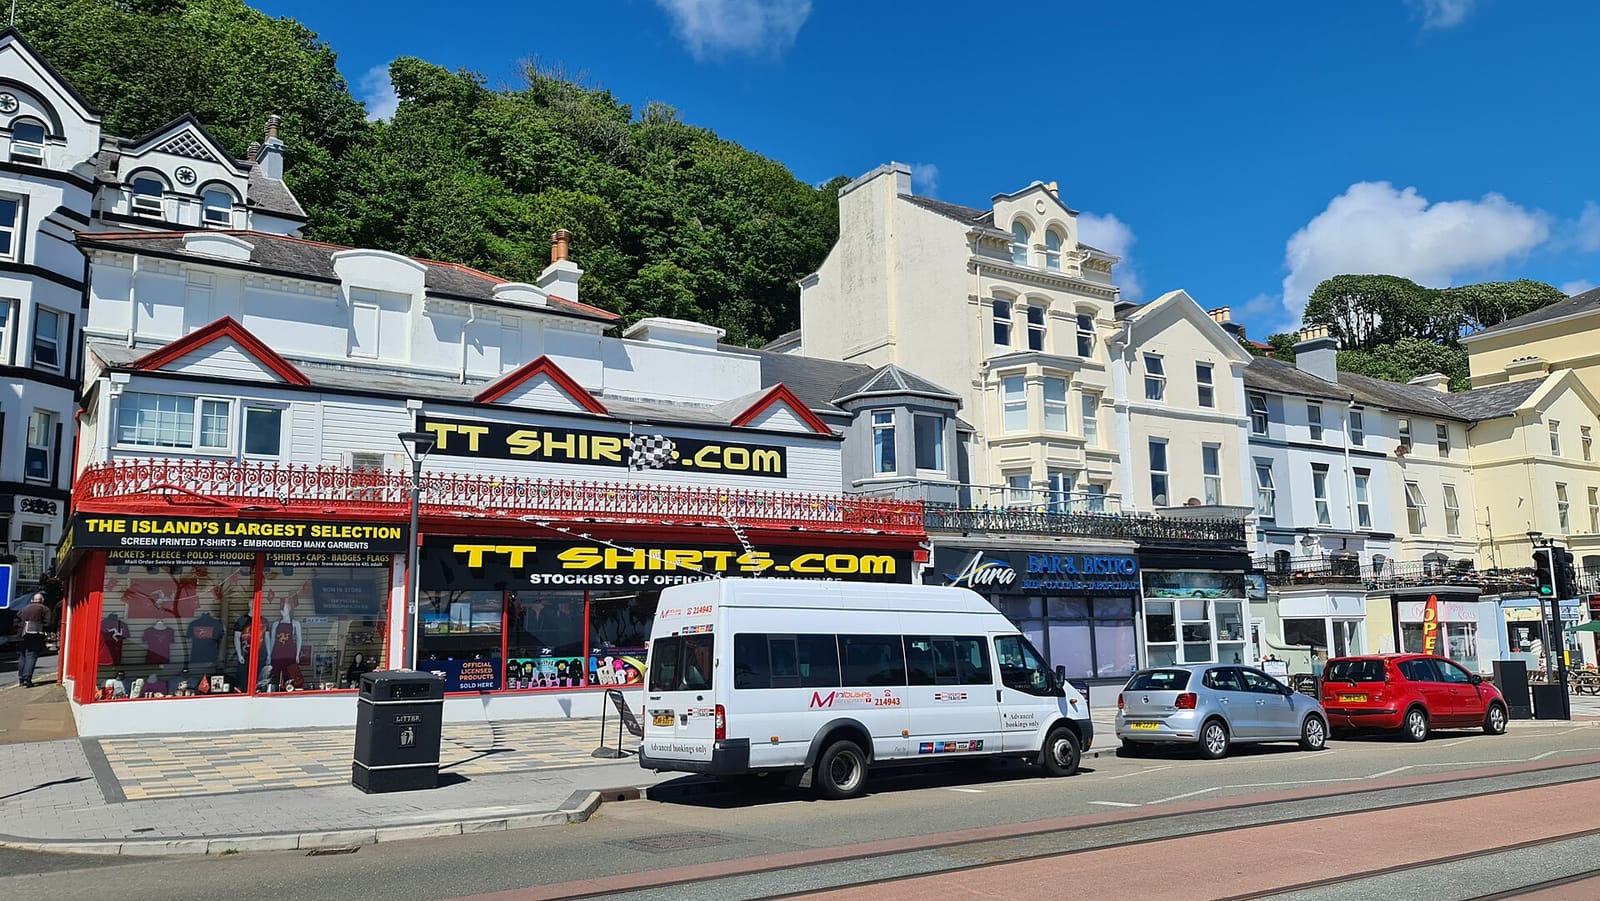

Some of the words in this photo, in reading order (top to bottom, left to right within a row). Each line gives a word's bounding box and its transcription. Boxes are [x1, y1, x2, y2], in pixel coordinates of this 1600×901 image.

[425, 422, 489, 452] TT
[506, 429, 781, 473] SHIR.COM
[85, 519, 126, 533] THE
[132, 520, 219, 534] ISLAND'S
[224, 521, 306, 537] LARGEST
[310, 524, 401, 539] SELECTION
[121, 537, 158, 546] SCREEN
[159, 538, 197, 546] PRINTED
[199, 538, 237, 546] T-SHIRTS
[243, 539, 302, 548] EMBROIDERED
[303, 540, 327, 549] MANX
[327, 541, 369, 549] GARMENTS
[108, 550, 145, 558] JACKETS
[151, 551, 181, 559] FLEECE
[186, 551, 214, 559] POLOS
[220, 552, 255, 560] HOODIES
[265, 553, 301, 561] T-SHIRTS
[331, 554, 361, 562] BADGES
[453, 544, 537, 568] TT
[949, 551, 1017, 588] Aura
[1028, 554, 1062, 574] BAR
[1065, 555, 1079, 574] &
[1082, 555, 1136, 575] BISTRO
[529, 573, 624, 585] STOCKISTS
[628, 574, 649, 585] OF
[1423, 608, 1437, 655] OPE
[874, 698, 901, 706] 214943
[1028, 720, 1039, 728] only
[650, 744, 672, 752] Advanced
[673, 744, 695, 754] bookings
[695, 744, 707, 755] only
